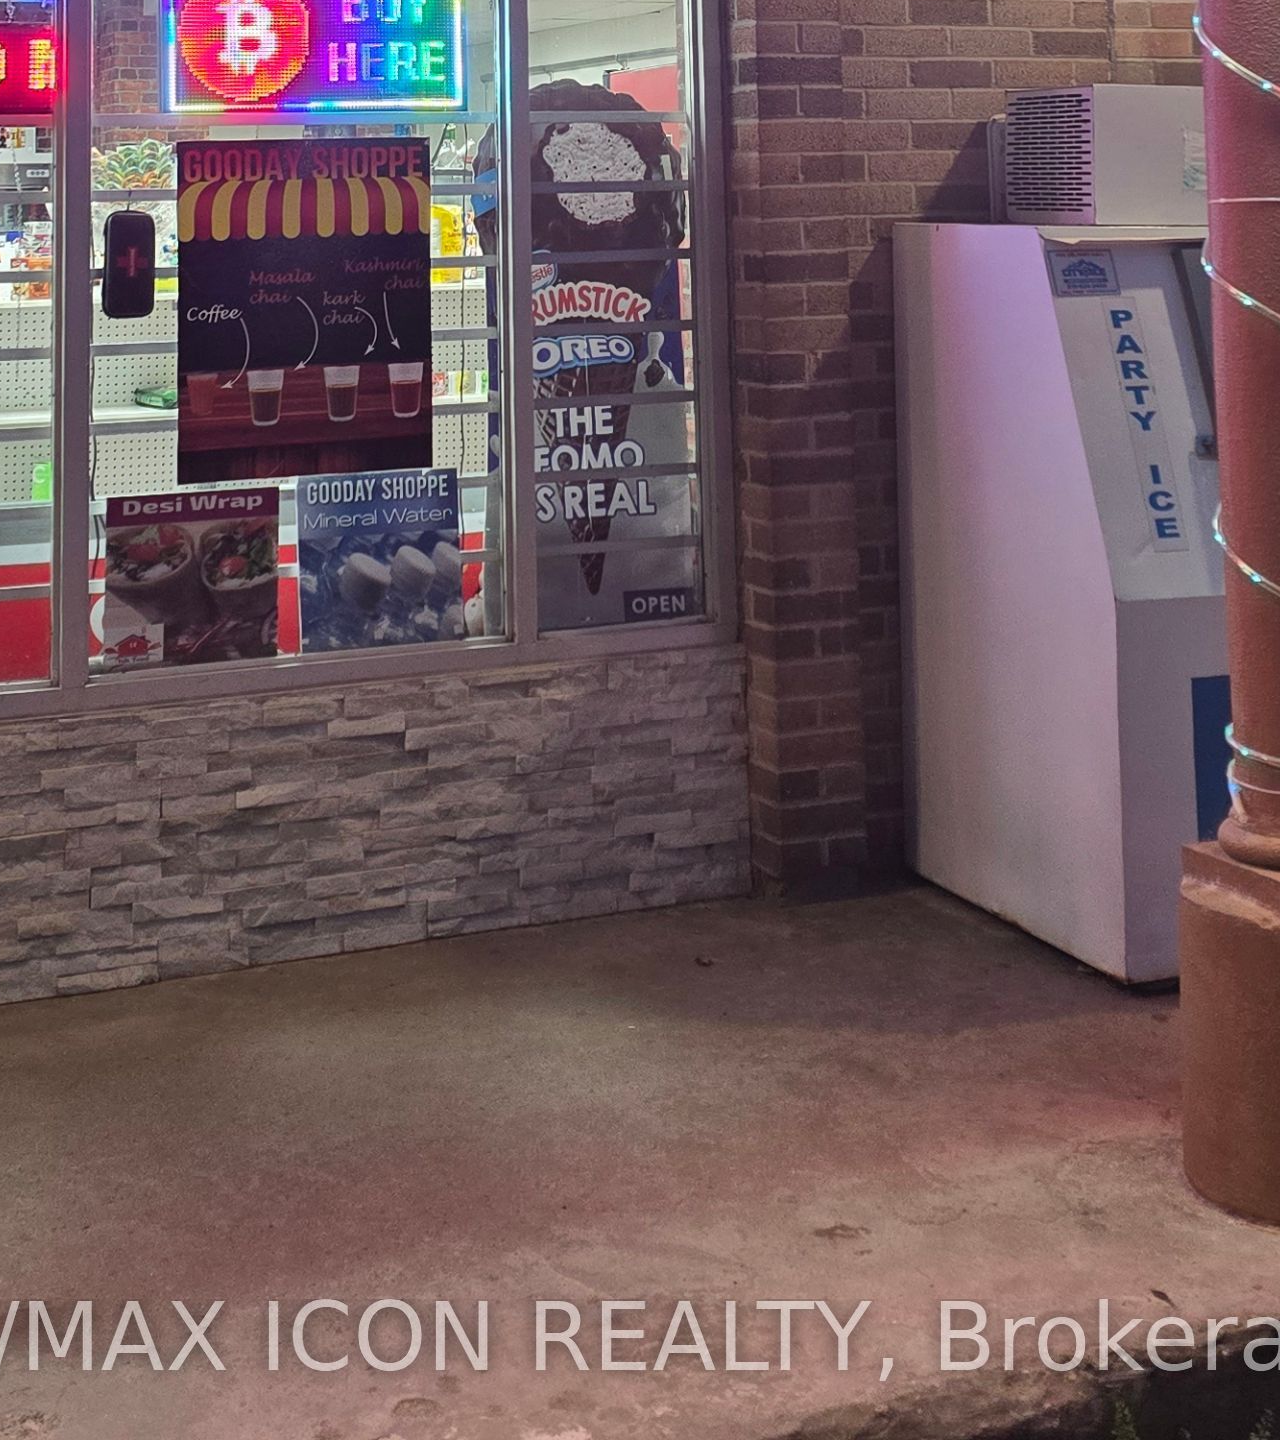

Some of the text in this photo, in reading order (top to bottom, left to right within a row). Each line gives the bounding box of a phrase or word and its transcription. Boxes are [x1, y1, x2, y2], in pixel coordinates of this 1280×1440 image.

[327, 40, 446, 83] HERE
[183, 144, 424, 184] GOODAY SHOPPE
[249, 268, 316, 286] Masala
[344, 257, 425, 274] Kashmiri
[384, 274, 425, 291] chai
[249, 289, 293, 305] chai
[322, 290, 369, 306] kark
[531, 284, 648, 323] RUMSTICK
[186, 303, 244, 324] Coffee
[322, 309, 366, 327] chai
[532, 337, 631, 372] OREO
[550, 405, 614, 438] THE
[1109, 307, 1182, 541] PARTY ICE
[534, 440, 644, 474] FOMO
[307, 474, 449, 505] GOODAY SHOPPE
[535, 479, 658, 522] S REAL
[122, 493, 264, 517] Desi Wrap
[303, 507, 454, 531] Mineral Water
[631, 594, 687, 615] OPEN
